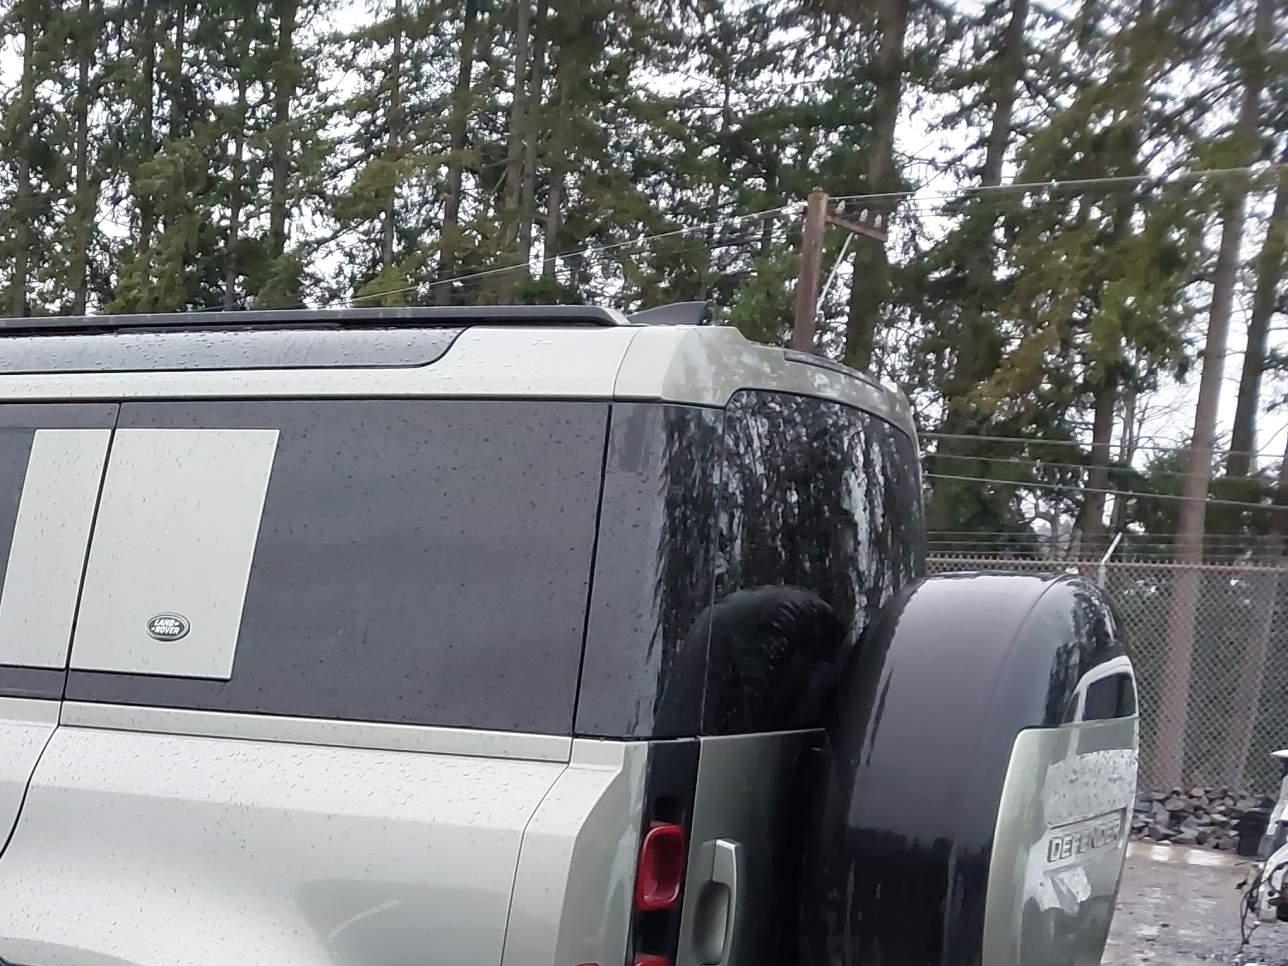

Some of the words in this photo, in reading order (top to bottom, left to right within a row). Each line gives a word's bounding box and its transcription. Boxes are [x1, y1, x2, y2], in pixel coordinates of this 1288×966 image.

[153, 619, 176, 627] LAND
[154, 626, 181, 635] ROVER
[1047, 817, 1121, 863] DEFENDER
